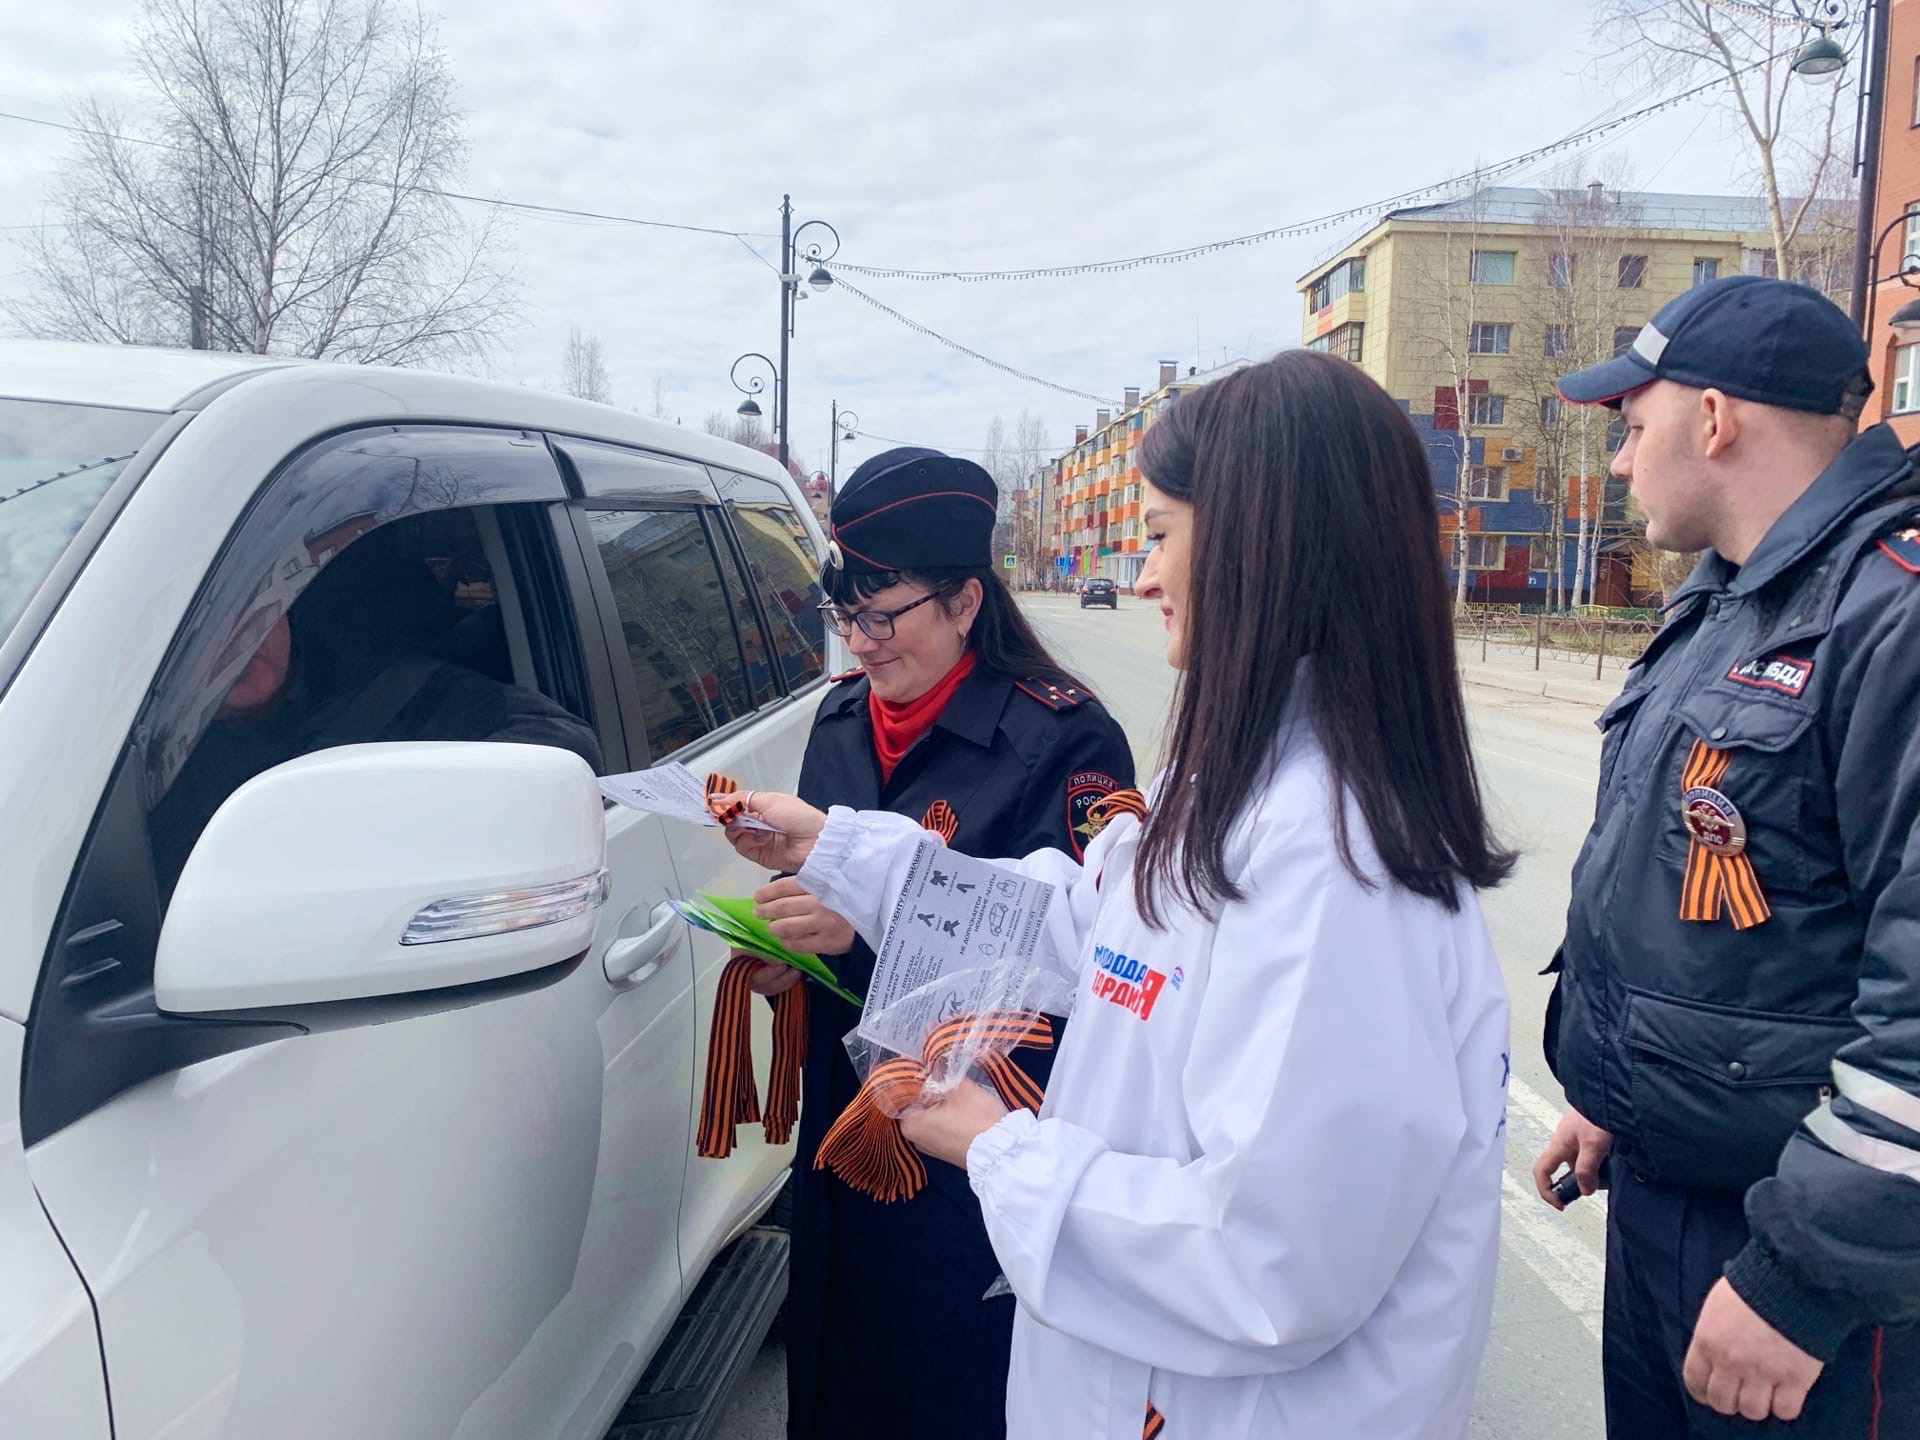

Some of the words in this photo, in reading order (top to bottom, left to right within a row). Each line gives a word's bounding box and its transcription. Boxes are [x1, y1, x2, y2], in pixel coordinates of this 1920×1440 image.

[1073, 774, 1113, 788] ПОЛИЦИЯ
[871, 925, 895, 992] ГЕОРГИЕВСКУЮ
[891, 896, 905, 925] ЛЕНТУ
[900, 840, 926, 897] ПРАВИЛЬНО!
[962, 895, 983, 945] ДОПУСКАЕТСЯ
